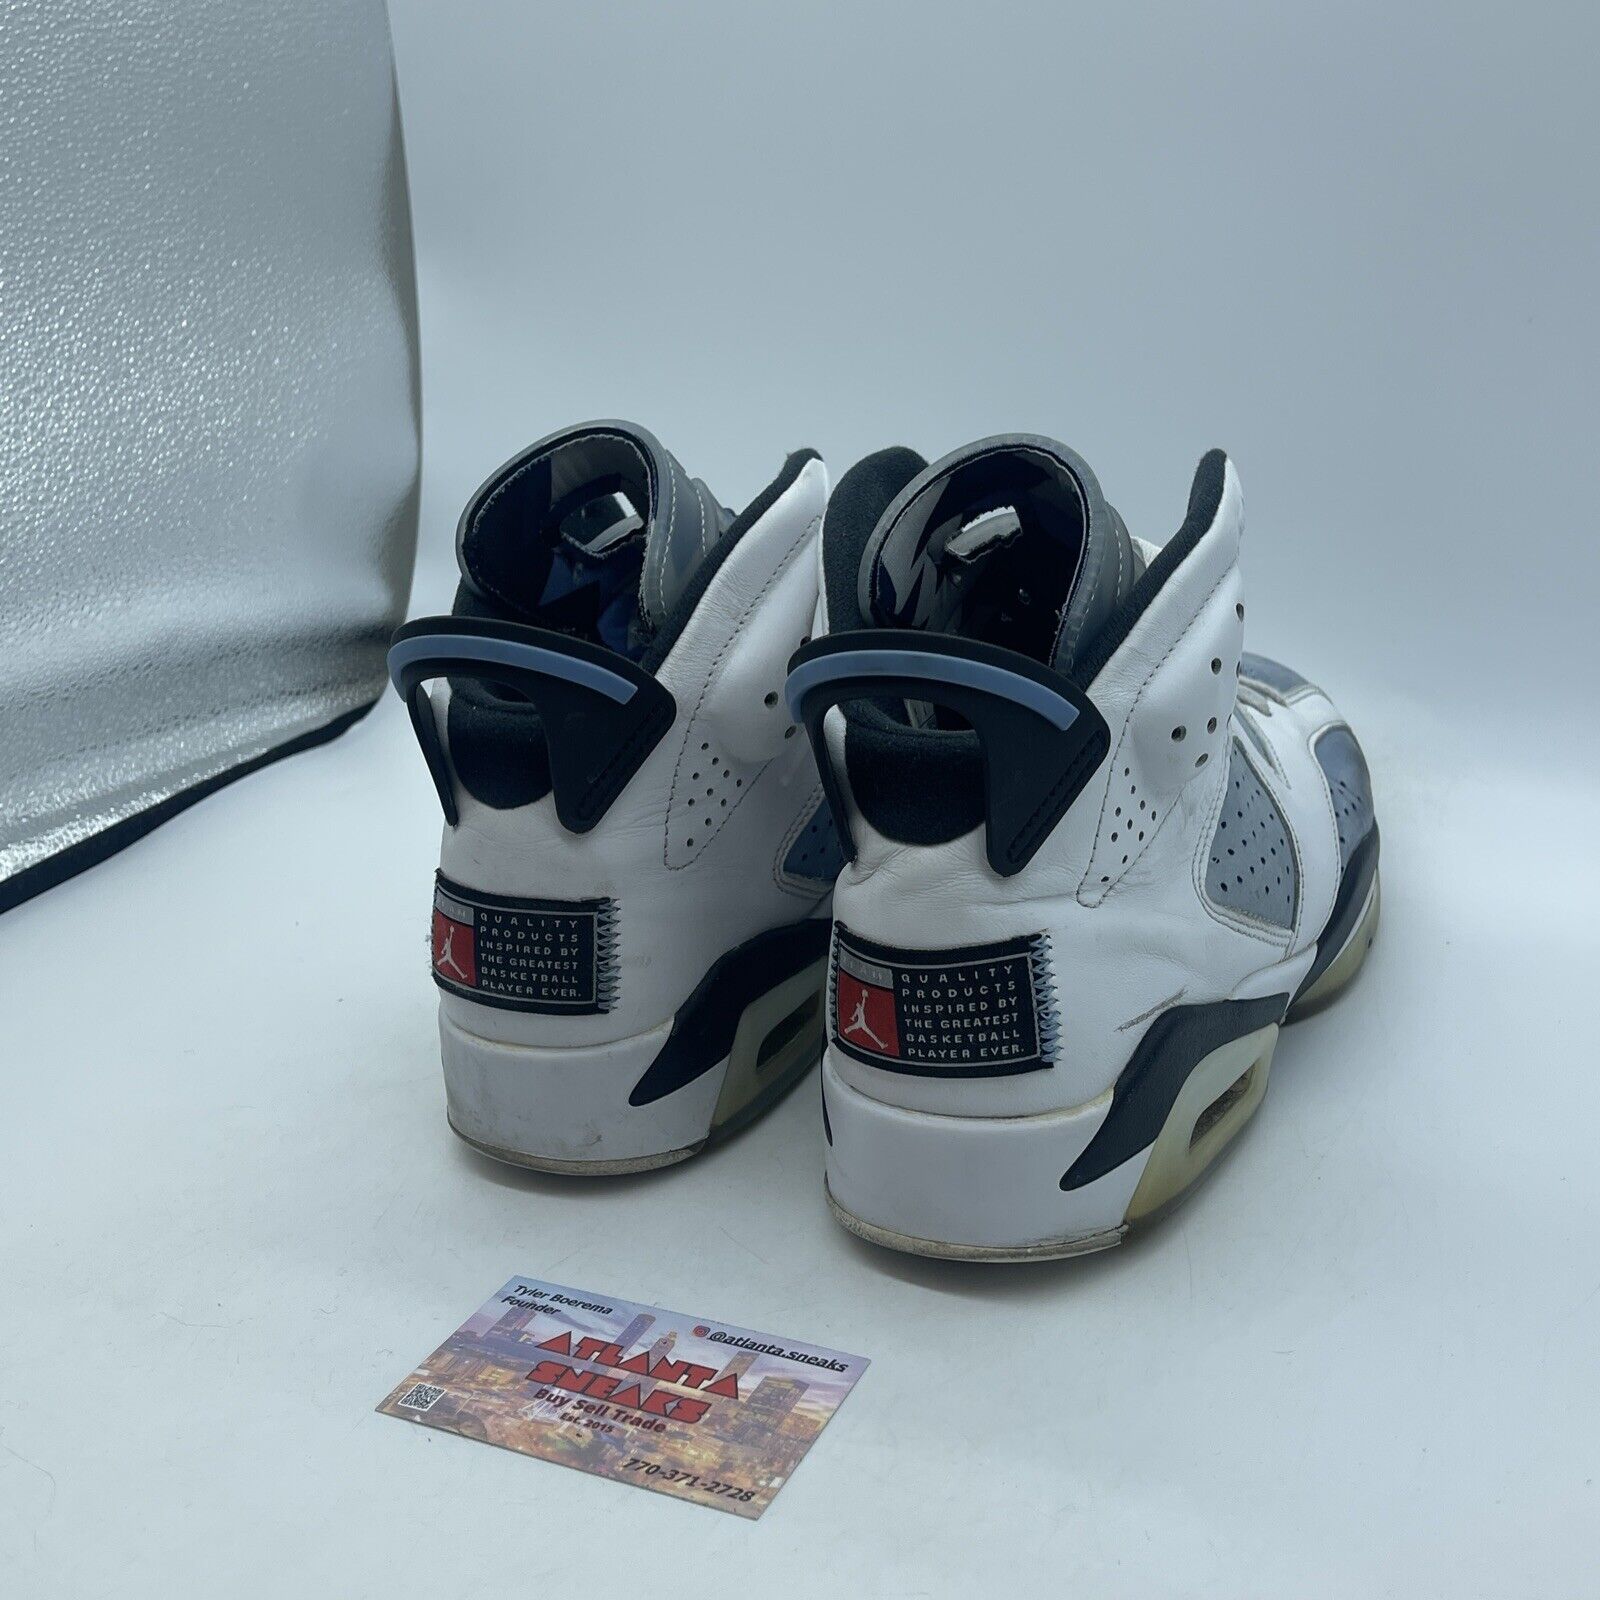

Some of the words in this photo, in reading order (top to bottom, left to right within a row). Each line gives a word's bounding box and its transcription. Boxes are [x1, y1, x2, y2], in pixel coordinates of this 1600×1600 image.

[481, 912, 579, 929] QUALITY
[480, 926, 578, 942] PRODUCTS
[480, 940, 552, 956] INSPIRED
[560, 947, 579, 956] BY
[481, 953, 508, 964] THE
[509, 955, 579, 970] GREATEST
[481, 966, 579, 984] BASKETBALL
[901, 965, 1013, 983] QUALITY
[482, 980, 534, 995] PLAYER
[541, 988, 582, 997] EVER.
[902, 982, 1016, 998] PRODUCTS
[903, 1001, 989, 1014] INSPIRED
[998, 997, 1018, 1009] BY
[904, 1018, 933, 1029] THE
[940, 1012, 1019, 1029] GREATEST
[905, 1029, 1020, 1044] BASKETBALL
[907, 1047, 971, 1059] PLAYER
[979, 1045, 1025, 1057] EVER.
[501, 1295, 562, 1315] Founder
[514, 1285, 551, 1299] Tyler
[549, 1293, 614, 1315] Boerema
[706, 1331, 850, 1373] @atlanta.sneaks
[535, 1331, 739, 1400] ATLANTA
[525, 1360, 713, 1425] SNEAKS
[533, 1388, 570, 1408] Buy
[571, 1398, 609, 1417] Sell
[609, 1409, 667, 1433] Trade
[559, 1412, 581, 1425] Est.
[584, 1420, 615, 1434] 2015
[622, 1458, 756, 1502] 770-371-2728
